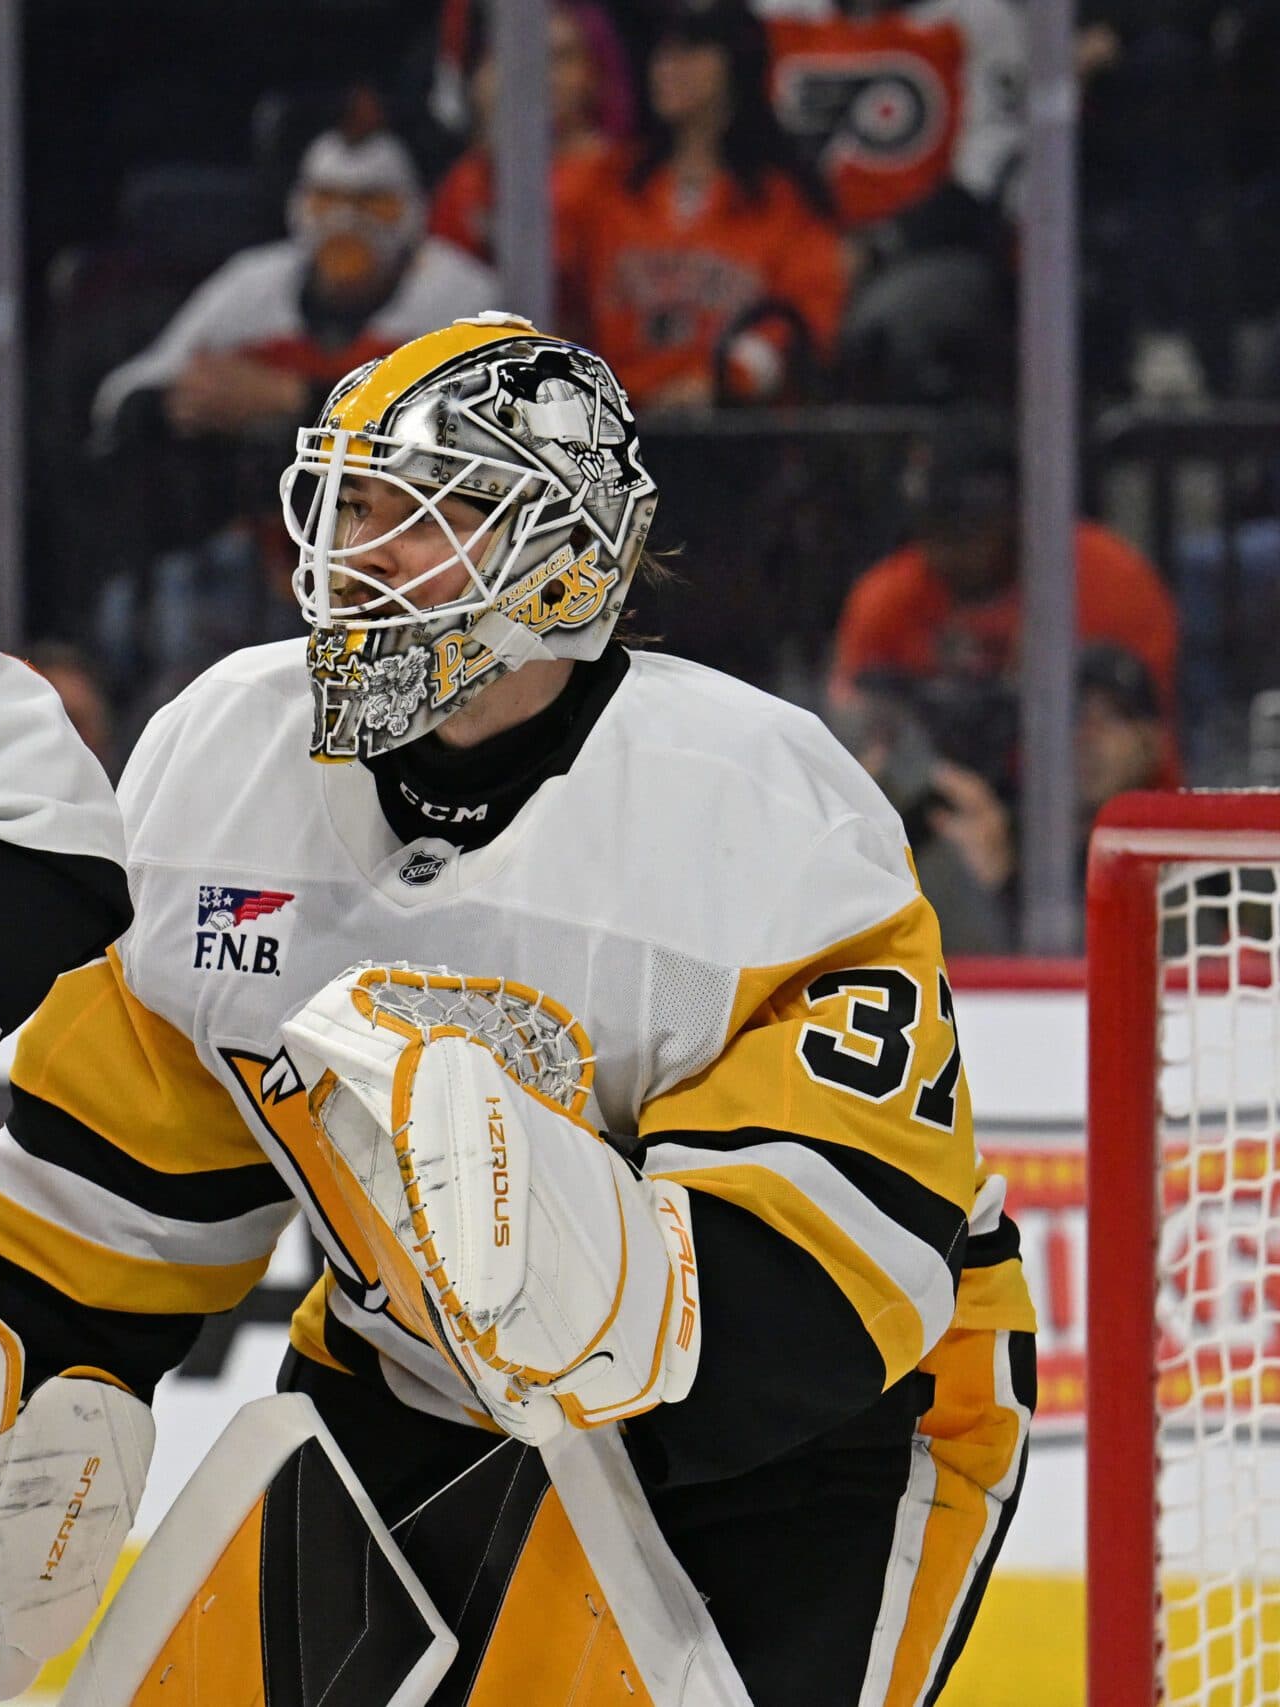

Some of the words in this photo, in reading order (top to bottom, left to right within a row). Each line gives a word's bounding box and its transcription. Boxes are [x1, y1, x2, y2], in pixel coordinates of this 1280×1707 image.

[400, 781, 488, 822] CCM
[193, 931, 281, 977] F.N.B.
[796, 965, 961, 1136] 37
[658, 1196, 697, 1352] TRUE
